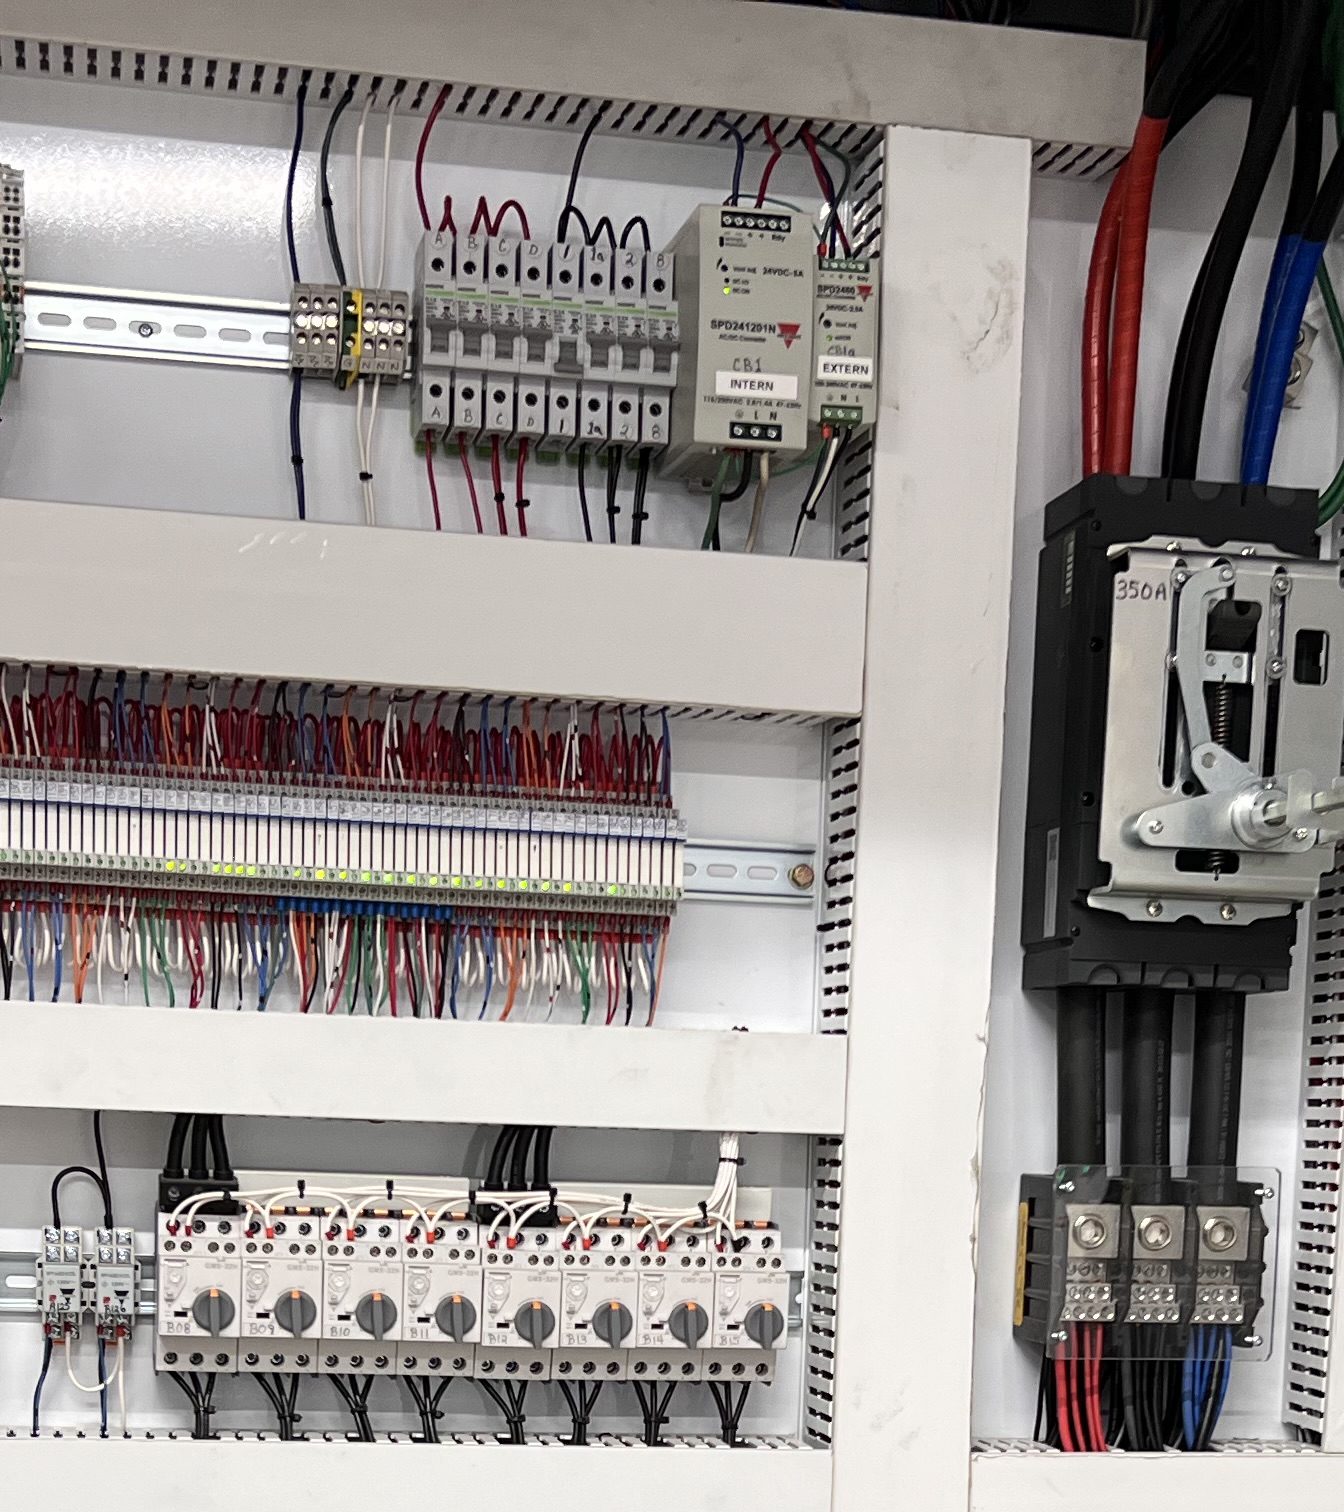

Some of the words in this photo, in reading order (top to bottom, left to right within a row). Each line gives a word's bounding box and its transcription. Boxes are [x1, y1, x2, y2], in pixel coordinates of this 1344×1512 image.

[823, 363, 869, 376] EXTERN
[730, 379, 774, 392] INTERN
[1115, 580, 1168, 601] 350A
